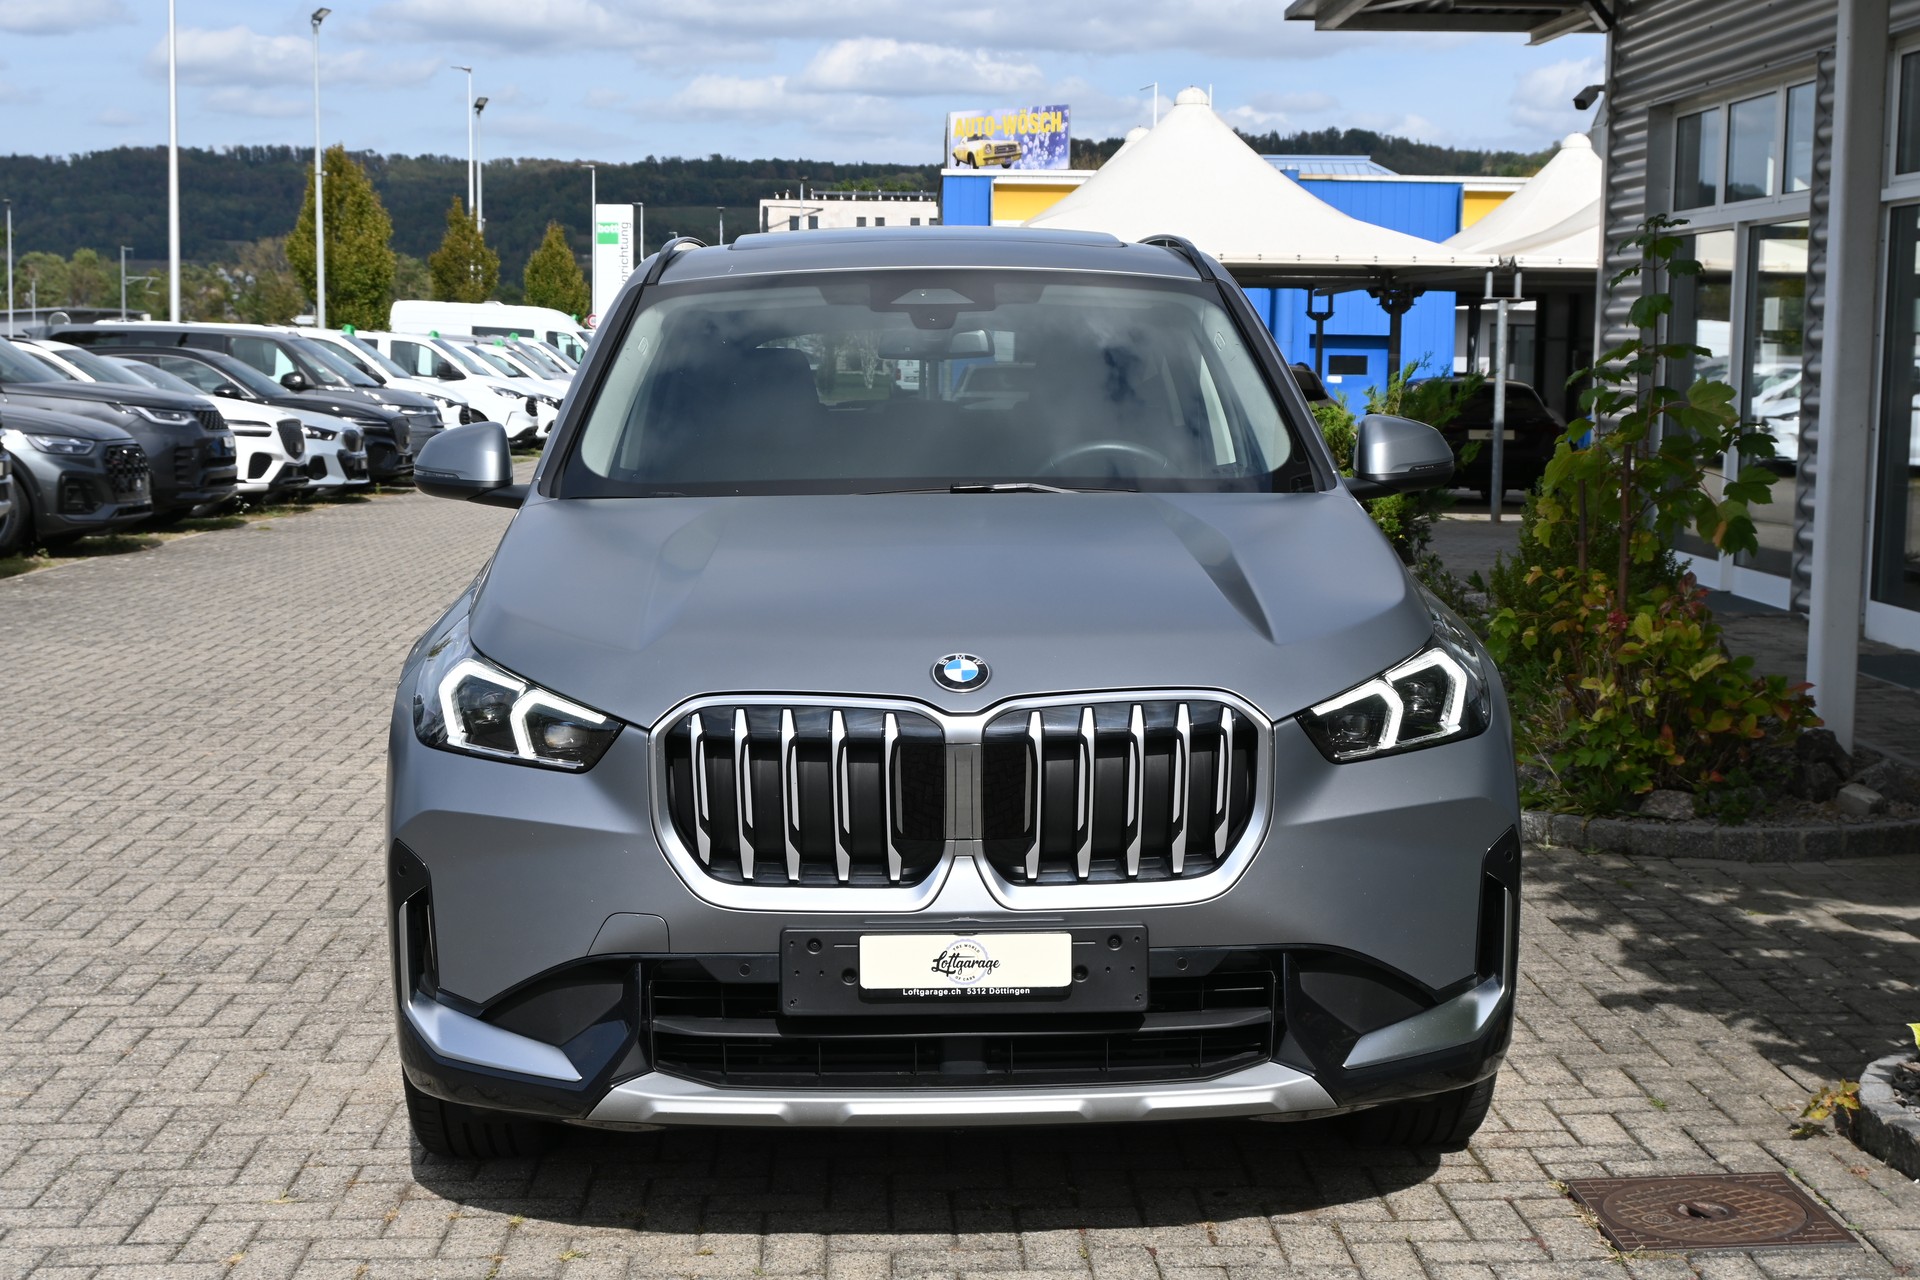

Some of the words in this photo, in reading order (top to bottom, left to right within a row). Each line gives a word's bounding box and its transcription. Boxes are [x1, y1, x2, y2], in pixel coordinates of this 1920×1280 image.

[954, 109, 1062, 138] AUTO-WÖSCH
[597, 223, 619, 233] bott
[619, 222, 632, 285] nrichtung
[938, 654, 984, 665] BMW
[964, 944, 980, 953] WORLD
[931, 950, 1000, 977] Loftgarage
[902, 988, 961, 996] Loftgarage.ch
[967, 987, 986, 995] 5312
[989, 987, 1030, 996] Döttingen
